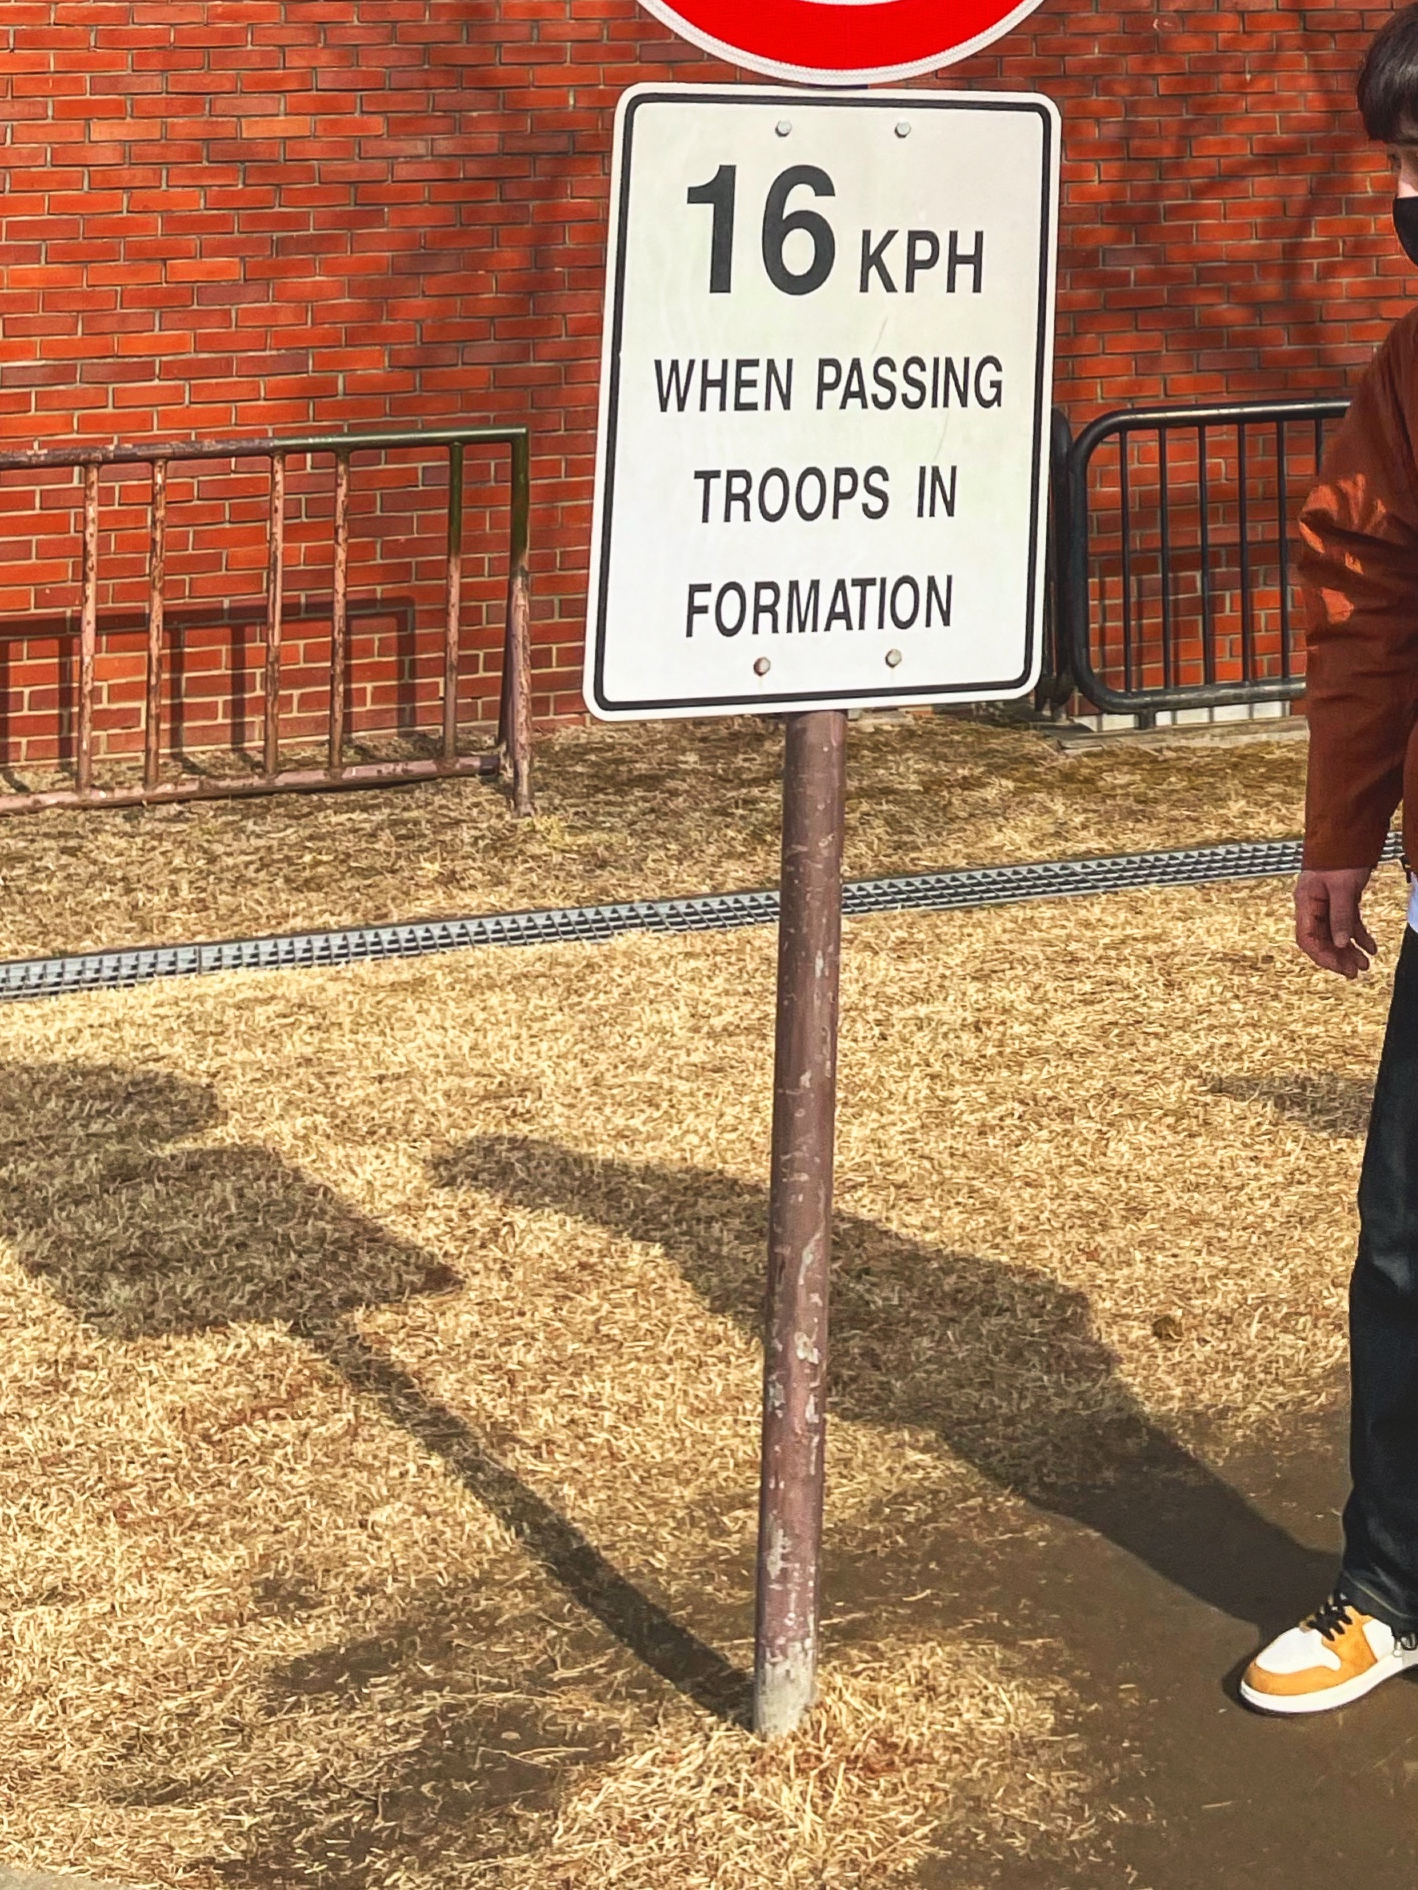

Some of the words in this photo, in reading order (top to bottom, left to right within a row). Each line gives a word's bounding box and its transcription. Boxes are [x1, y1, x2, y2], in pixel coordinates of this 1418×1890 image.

[686, 164, 837, 297] 16
[858, 229, 984, 295] KPH
[654, 357, 793, 413] WHEN
[815, 354, 1003, 412] PASSING
[694, 464, 891, 523] TROOPS
[916, 464, 958, 518] IN
[685, 574, 954, 638] FORMATION
